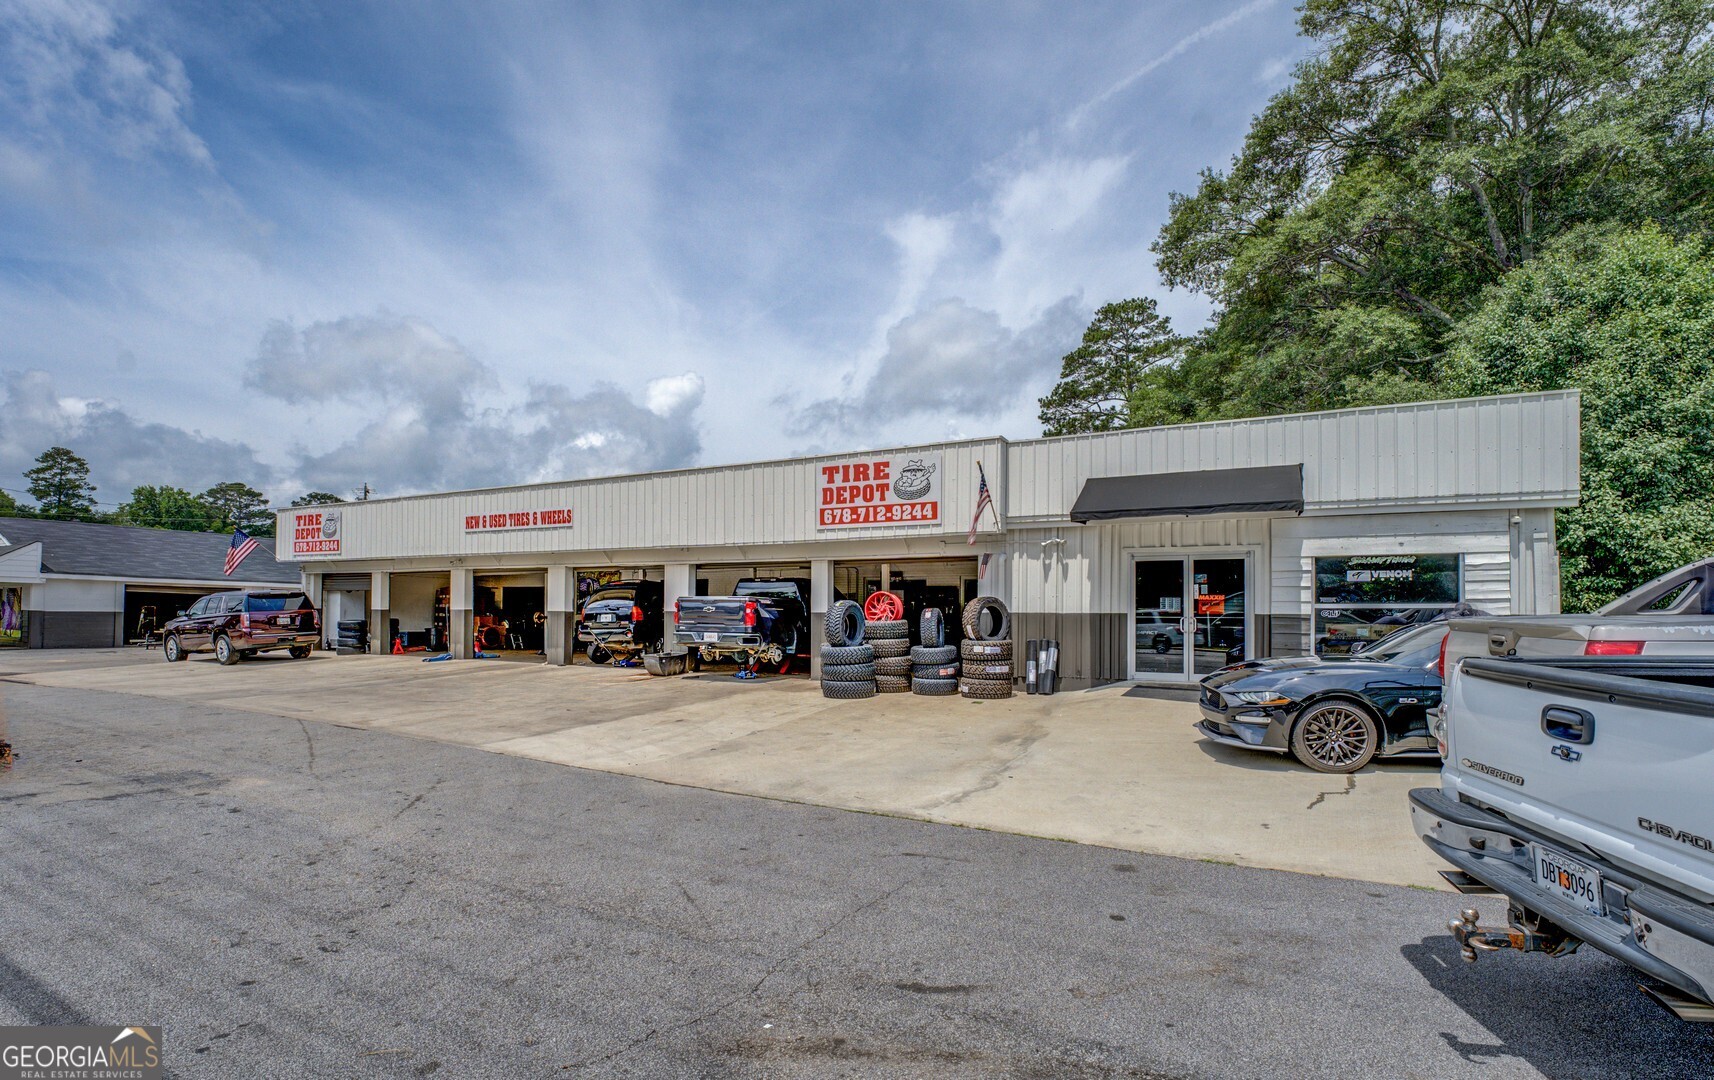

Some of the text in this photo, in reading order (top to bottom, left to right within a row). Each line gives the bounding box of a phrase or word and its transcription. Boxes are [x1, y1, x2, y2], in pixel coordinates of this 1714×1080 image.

[822, 461, 890, 484] TIRE
[822, 483, 890, 505] DEPOT
[295, 513, 322, 527] TIRE
[465, 509, 572, 529] NEW & USED TIRES & WHEELS
[823, 503, 933, 524] 678-712-9244
[295, 527, 322, 540] DEPOT
[295, 540, 338, 552] 678-712-9244
[1371, 569, 1412, 578] VENOM
[1471, 761, 1524, 786] SILVERADO
[1547, 852, 1586, 875] GEORGIA
[1541, 858, 1595, 903] DBT3096
